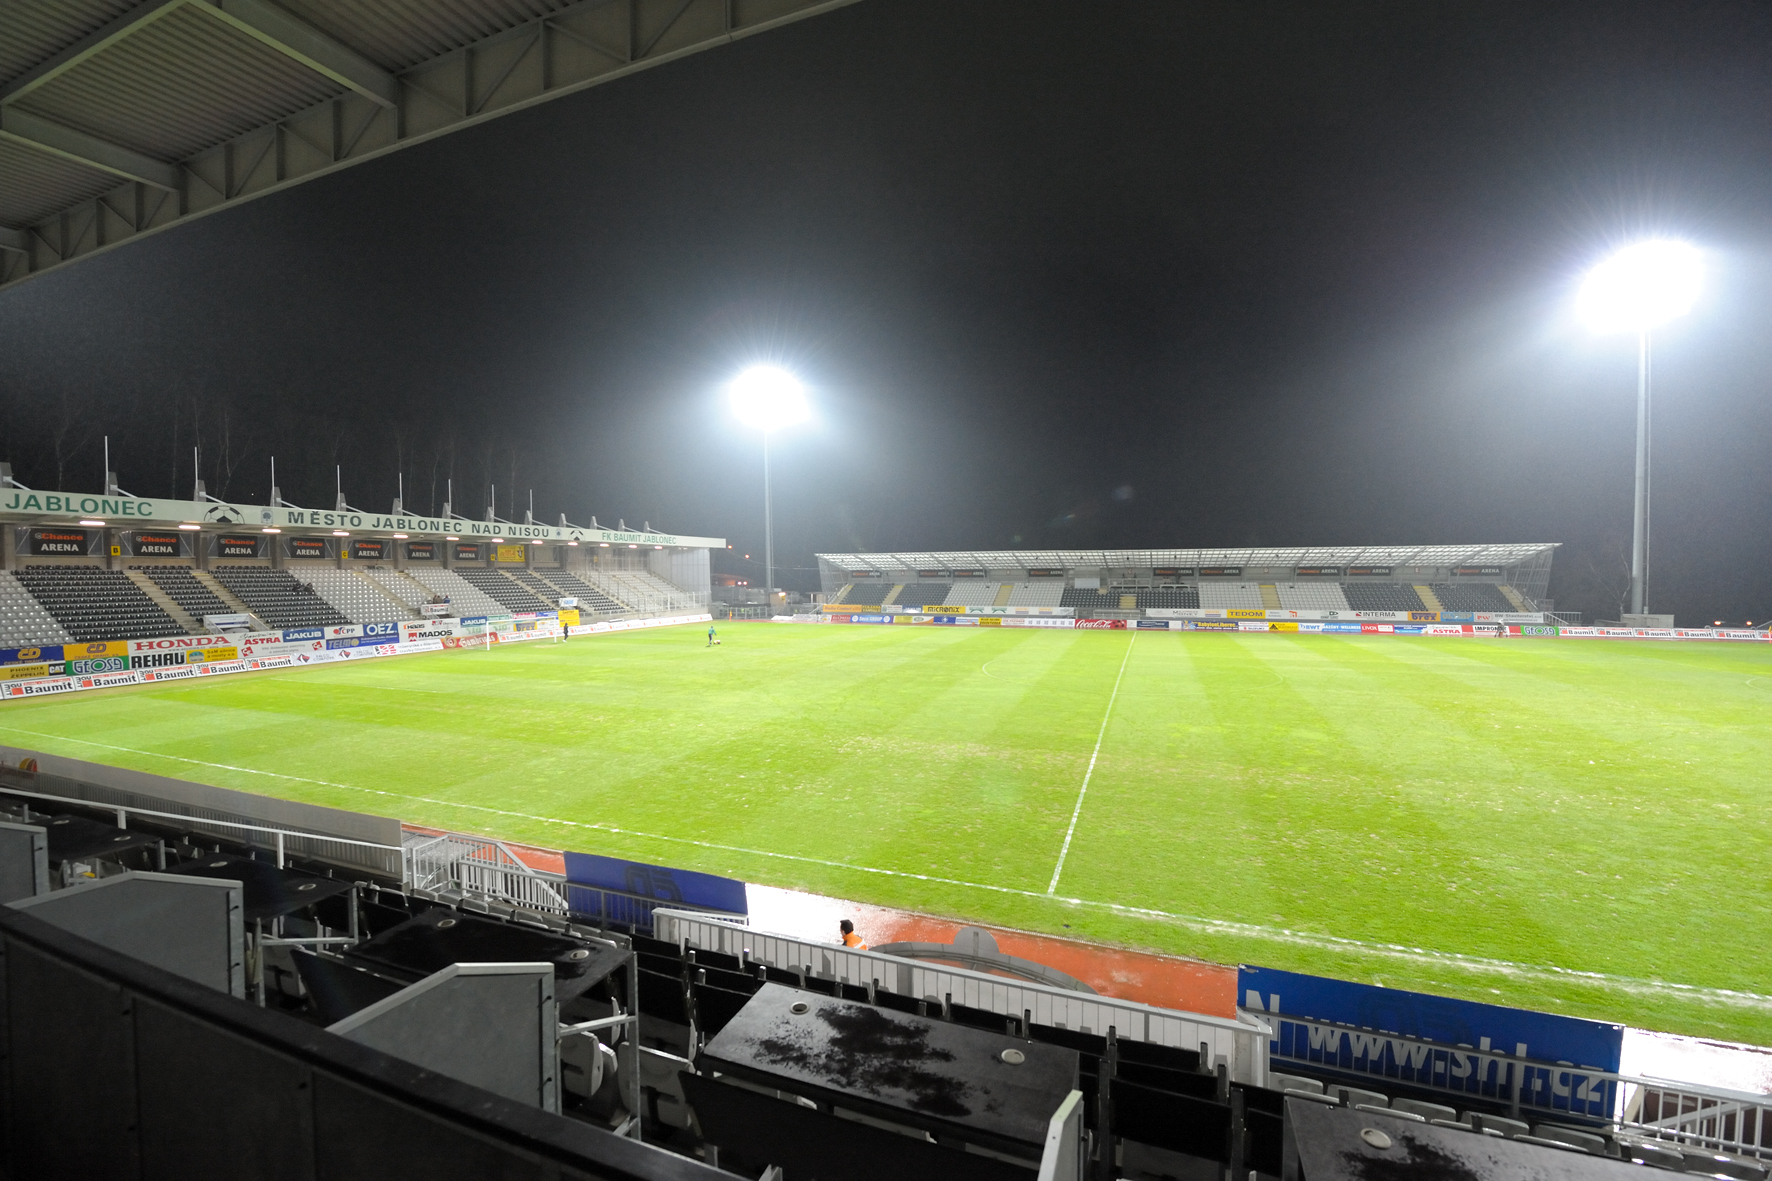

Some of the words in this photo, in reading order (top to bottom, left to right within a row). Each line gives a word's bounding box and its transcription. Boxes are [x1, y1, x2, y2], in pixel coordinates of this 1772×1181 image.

[5, 494, 153, 516] JABLONEC
[288, 511, 362, 527] MĚSTO
[372, 517, 462, 533] JABLONEC
[472, 524, 501, 535] NAD
[509, 527, 550, 538] NISOU
[602, 532, 612, 541] FK
[614, 533, 641, 542] BAUMIT
[643, 536, 677, 544] JABLONEC
[286, 631, 322, 639] JAKUB
[419, 630, 453, 638] MADOS
[134, 636, 231, 651] HONDA
[244, 637, 281, 645] ASTRA
[131, 652, 185, 669] REHAU
[260, 659, 292, 668] Baumit
[49, 665, 65, 674] CAT
[155, 669, 194, 680] Baumit
[211, 664, 246, 673] Baumit
[94, 674, 137, 687] Baumit
[24, 682, 73, 694] Baumit
[1246, 989, 1280, 1042] N
[1304, 1016, 1604, 1103] www.shl.cz
